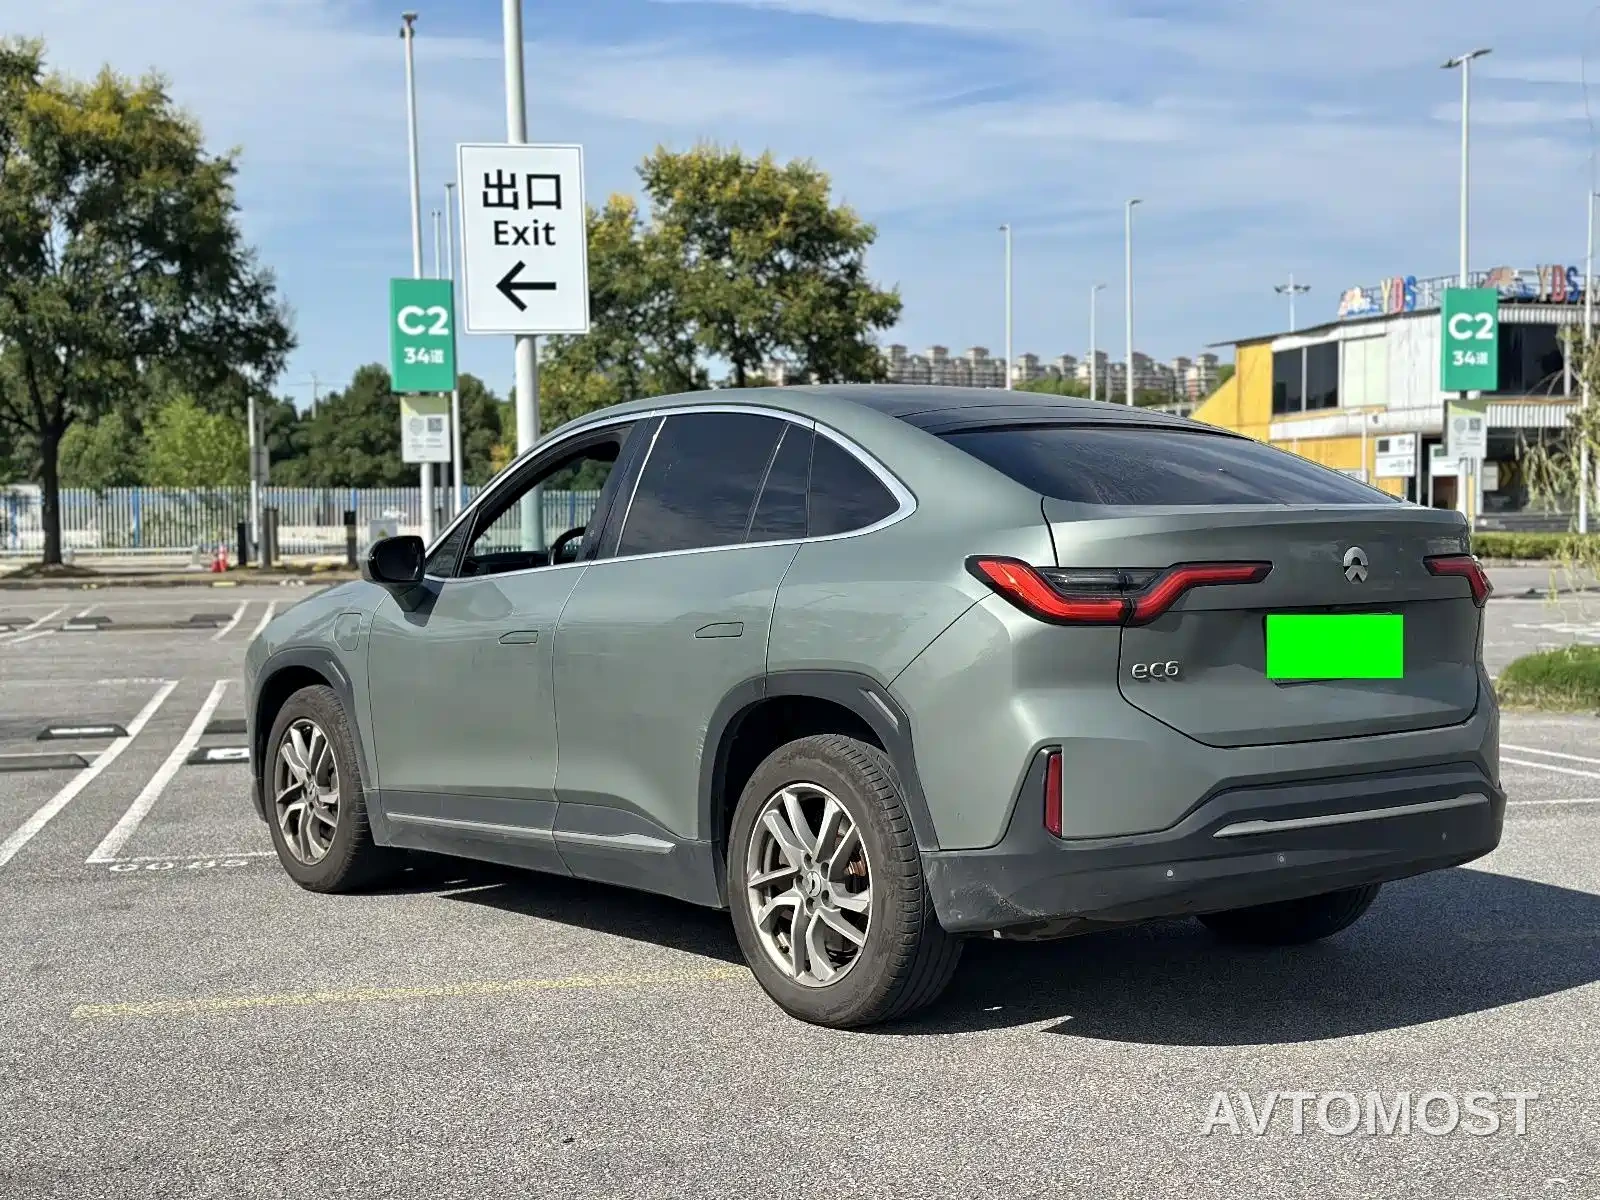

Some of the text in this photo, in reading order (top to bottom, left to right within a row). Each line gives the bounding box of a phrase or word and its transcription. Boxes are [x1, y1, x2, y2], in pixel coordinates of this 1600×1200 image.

[482, 169, 562, 210] 出口
[494, 219, 556, 246] Exit
[1380, 275, 1416, 314] YDS
[1536, 264, 1579, 303] YDS
[397, 305, 449, 336] C2
[1449, 312, 1494, 340] C2
